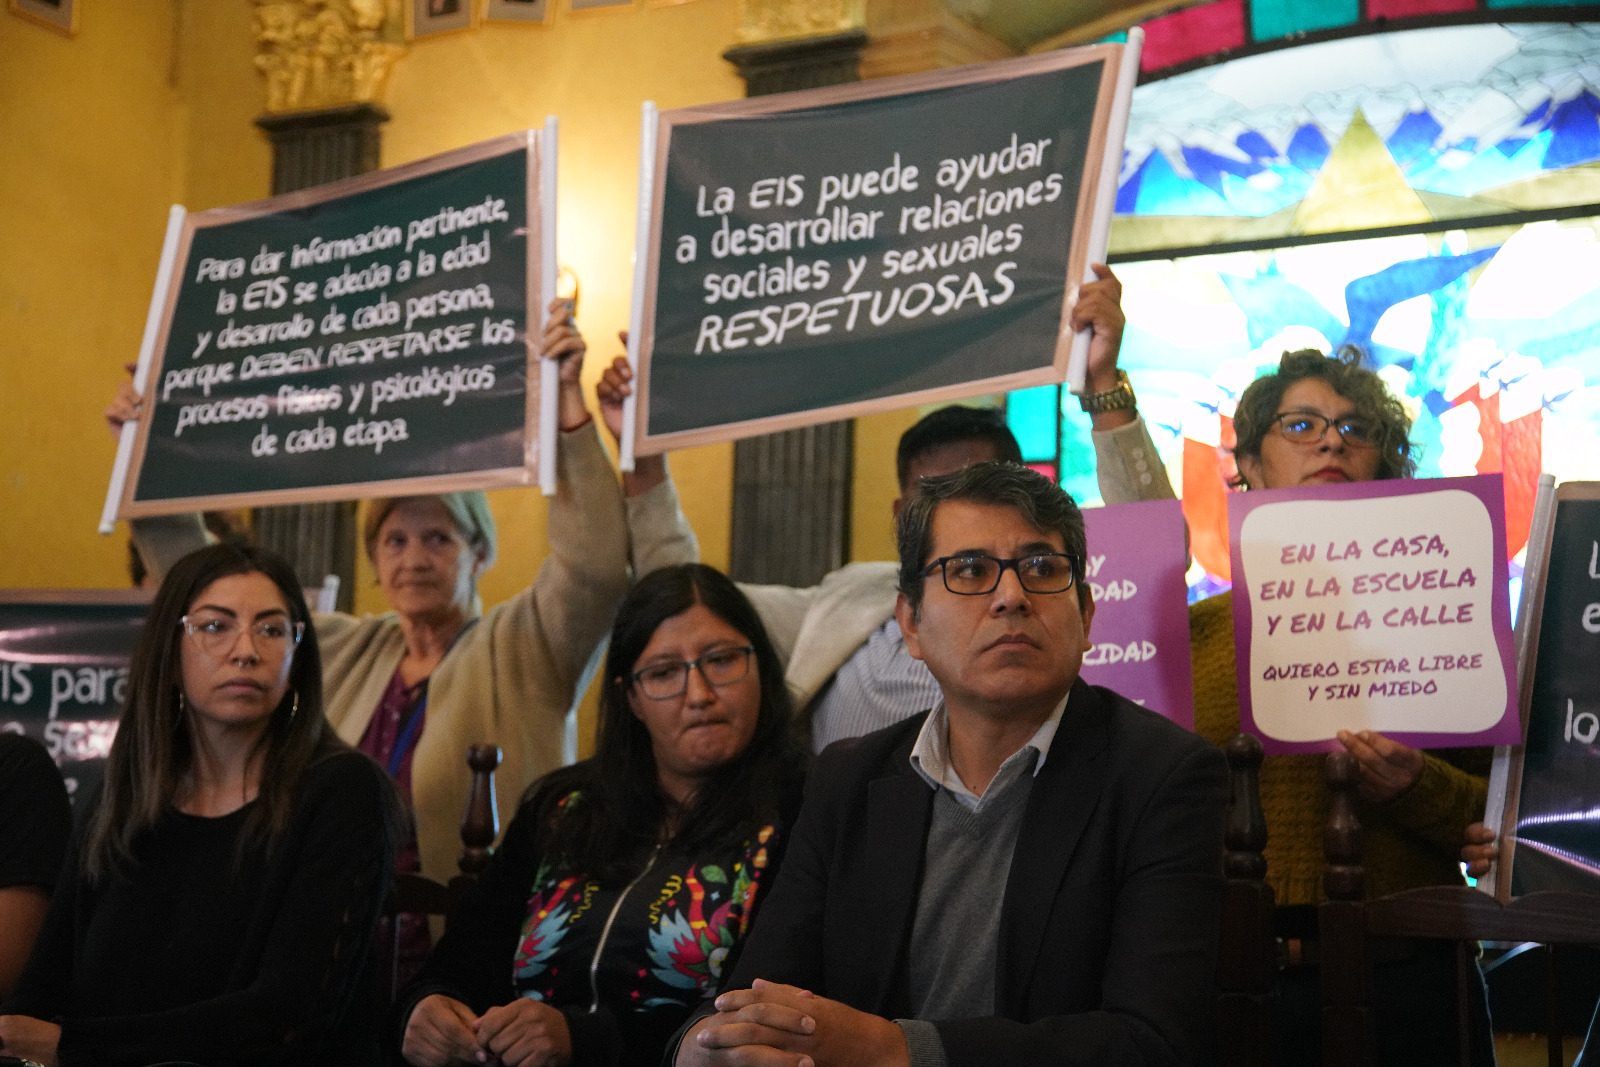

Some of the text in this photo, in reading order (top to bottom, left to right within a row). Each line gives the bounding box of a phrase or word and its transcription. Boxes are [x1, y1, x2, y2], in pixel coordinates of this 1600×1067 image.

[697, 132, 1052, 217] La EIS puede ayudar
[195, 194, 510, 284] Para dar información pertinente,
[675, 173, 1063, 264] a desarrollar relaciones
[216, 229, 491, 315] la EIS se adecúa a la edad
[703, 223, 1024, 304] sociales y sexuales
[192, 283, 495, 359] y desarrollo de cada persona,
[694, 261, 1018, 355] RESPETUOSAS
[162, 316, 516, 402] porque DEBEN RESPETARSE los
[174, 394, 270, 437] procesos
[347, 382, 365, 415] y
[370, 364, 496, 416] psicológicos
[251, 423, 279, 457] de
[284, 415, 338, 454] cada
[1260, 567, 1477, 601] EN LA ESCUELA
[1280, 534, 1450, 565] EN LA CASA,
[1091, 579, 1138, 602] DAD
[1267, 602, 1475, 637] Y EN LA CALLE
[1262, 653, 1484, 682] QUIERO ESTAR LIBRE
[1308, 678, 1438, 702] Y SIN MIEDO
